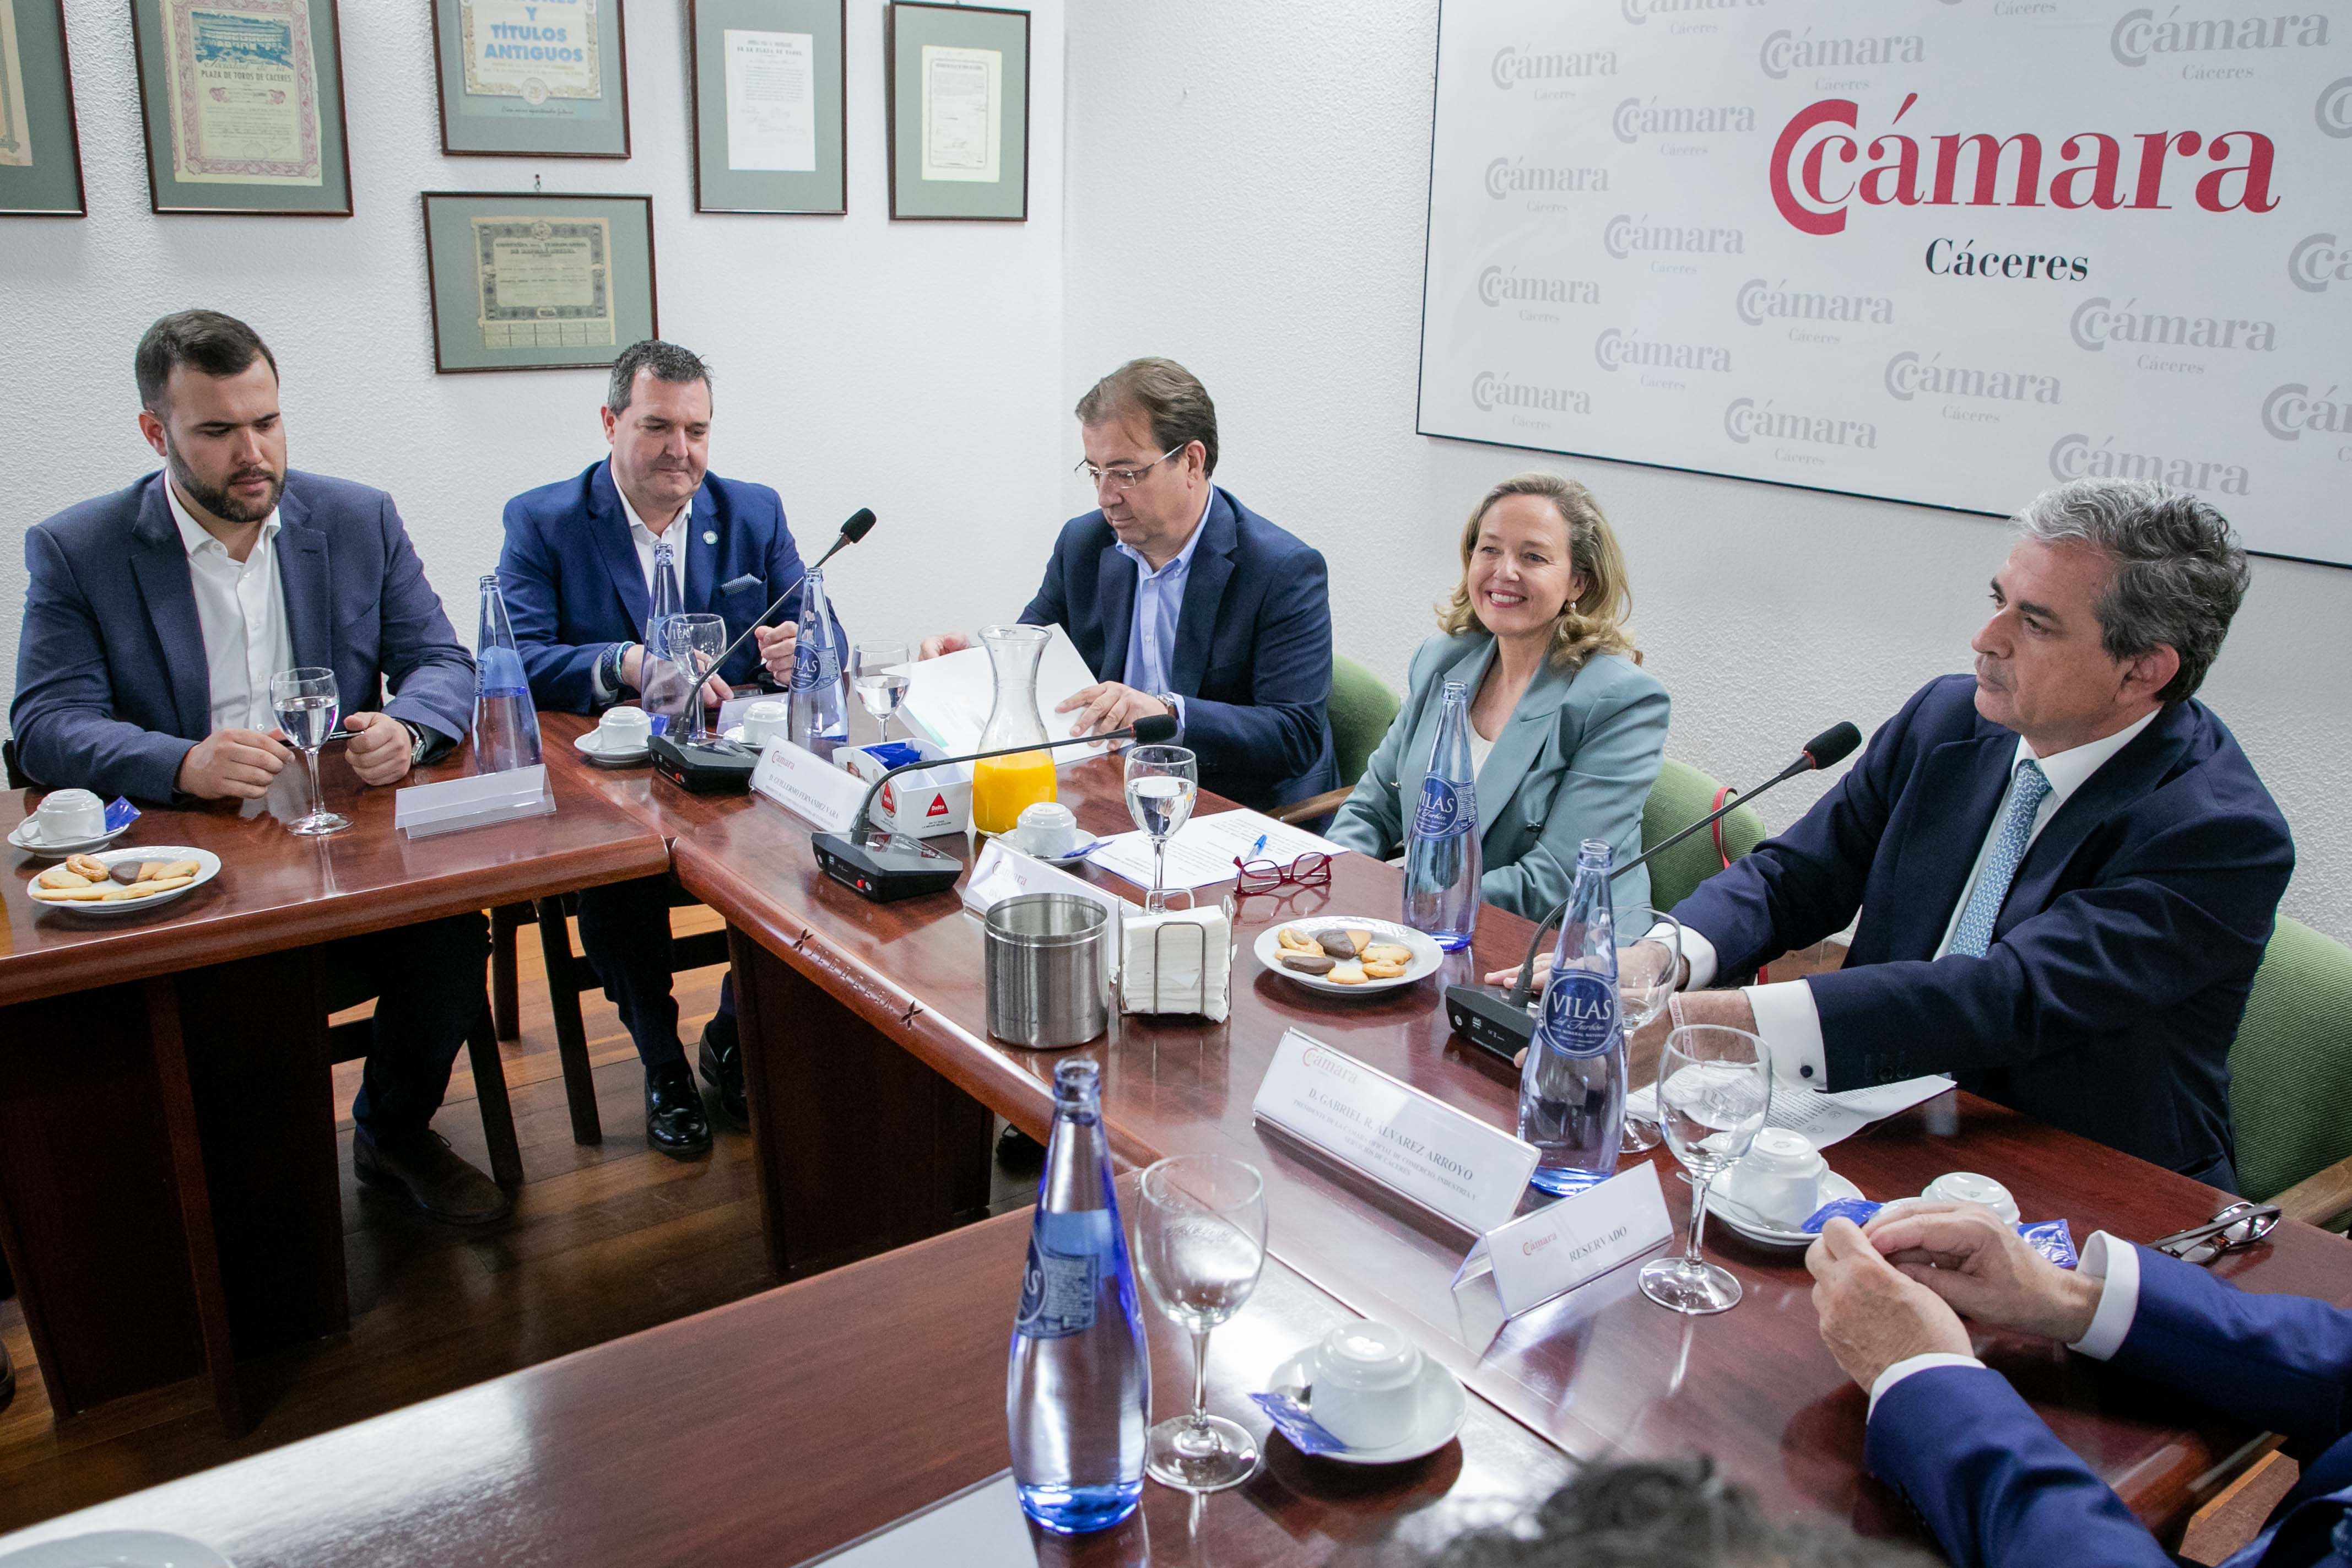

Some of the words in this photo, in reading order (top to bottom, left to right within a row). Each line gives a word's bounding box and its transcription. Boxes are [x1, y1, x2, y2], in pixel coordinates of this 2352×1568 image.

[525, 7, 538, 21] Y
[491, 21, 567, 42] TÍTULOS
[485, 44, 583, 62] ANTIGUOS
[201, 70, 221, 79] PLAZA
[224, 71, 232, 80] DE
[234, 72, 255, 81] TOROS
[256, 72, 264, 81] DE
[2182, 64, 2254, 80] Cáceres
[1925, 238, 2089, 282] Cáceres
[2137, 354, 2205, 374] Cáceres
[793, 655, 818, 673] ILAS
[1553, 991, 1612, 1020] VILAS
[1309, 1088, 1317, 1100] D.
[1320, 1094, 1362, 1123] GABRIEL
[1364, 1116, 1373, 1129] R.
[1376, 1120, 1425, 1156] ÁLVAREZ
[1425, 1150, 1473, 1181] ARROYO
[1293, 1099, 1326, 1120] PRESIDENTE
[1437, 1175, 1471, 1198] INDUSTRIA
[1569, 1226, 1628, 1263] RESERVADO
